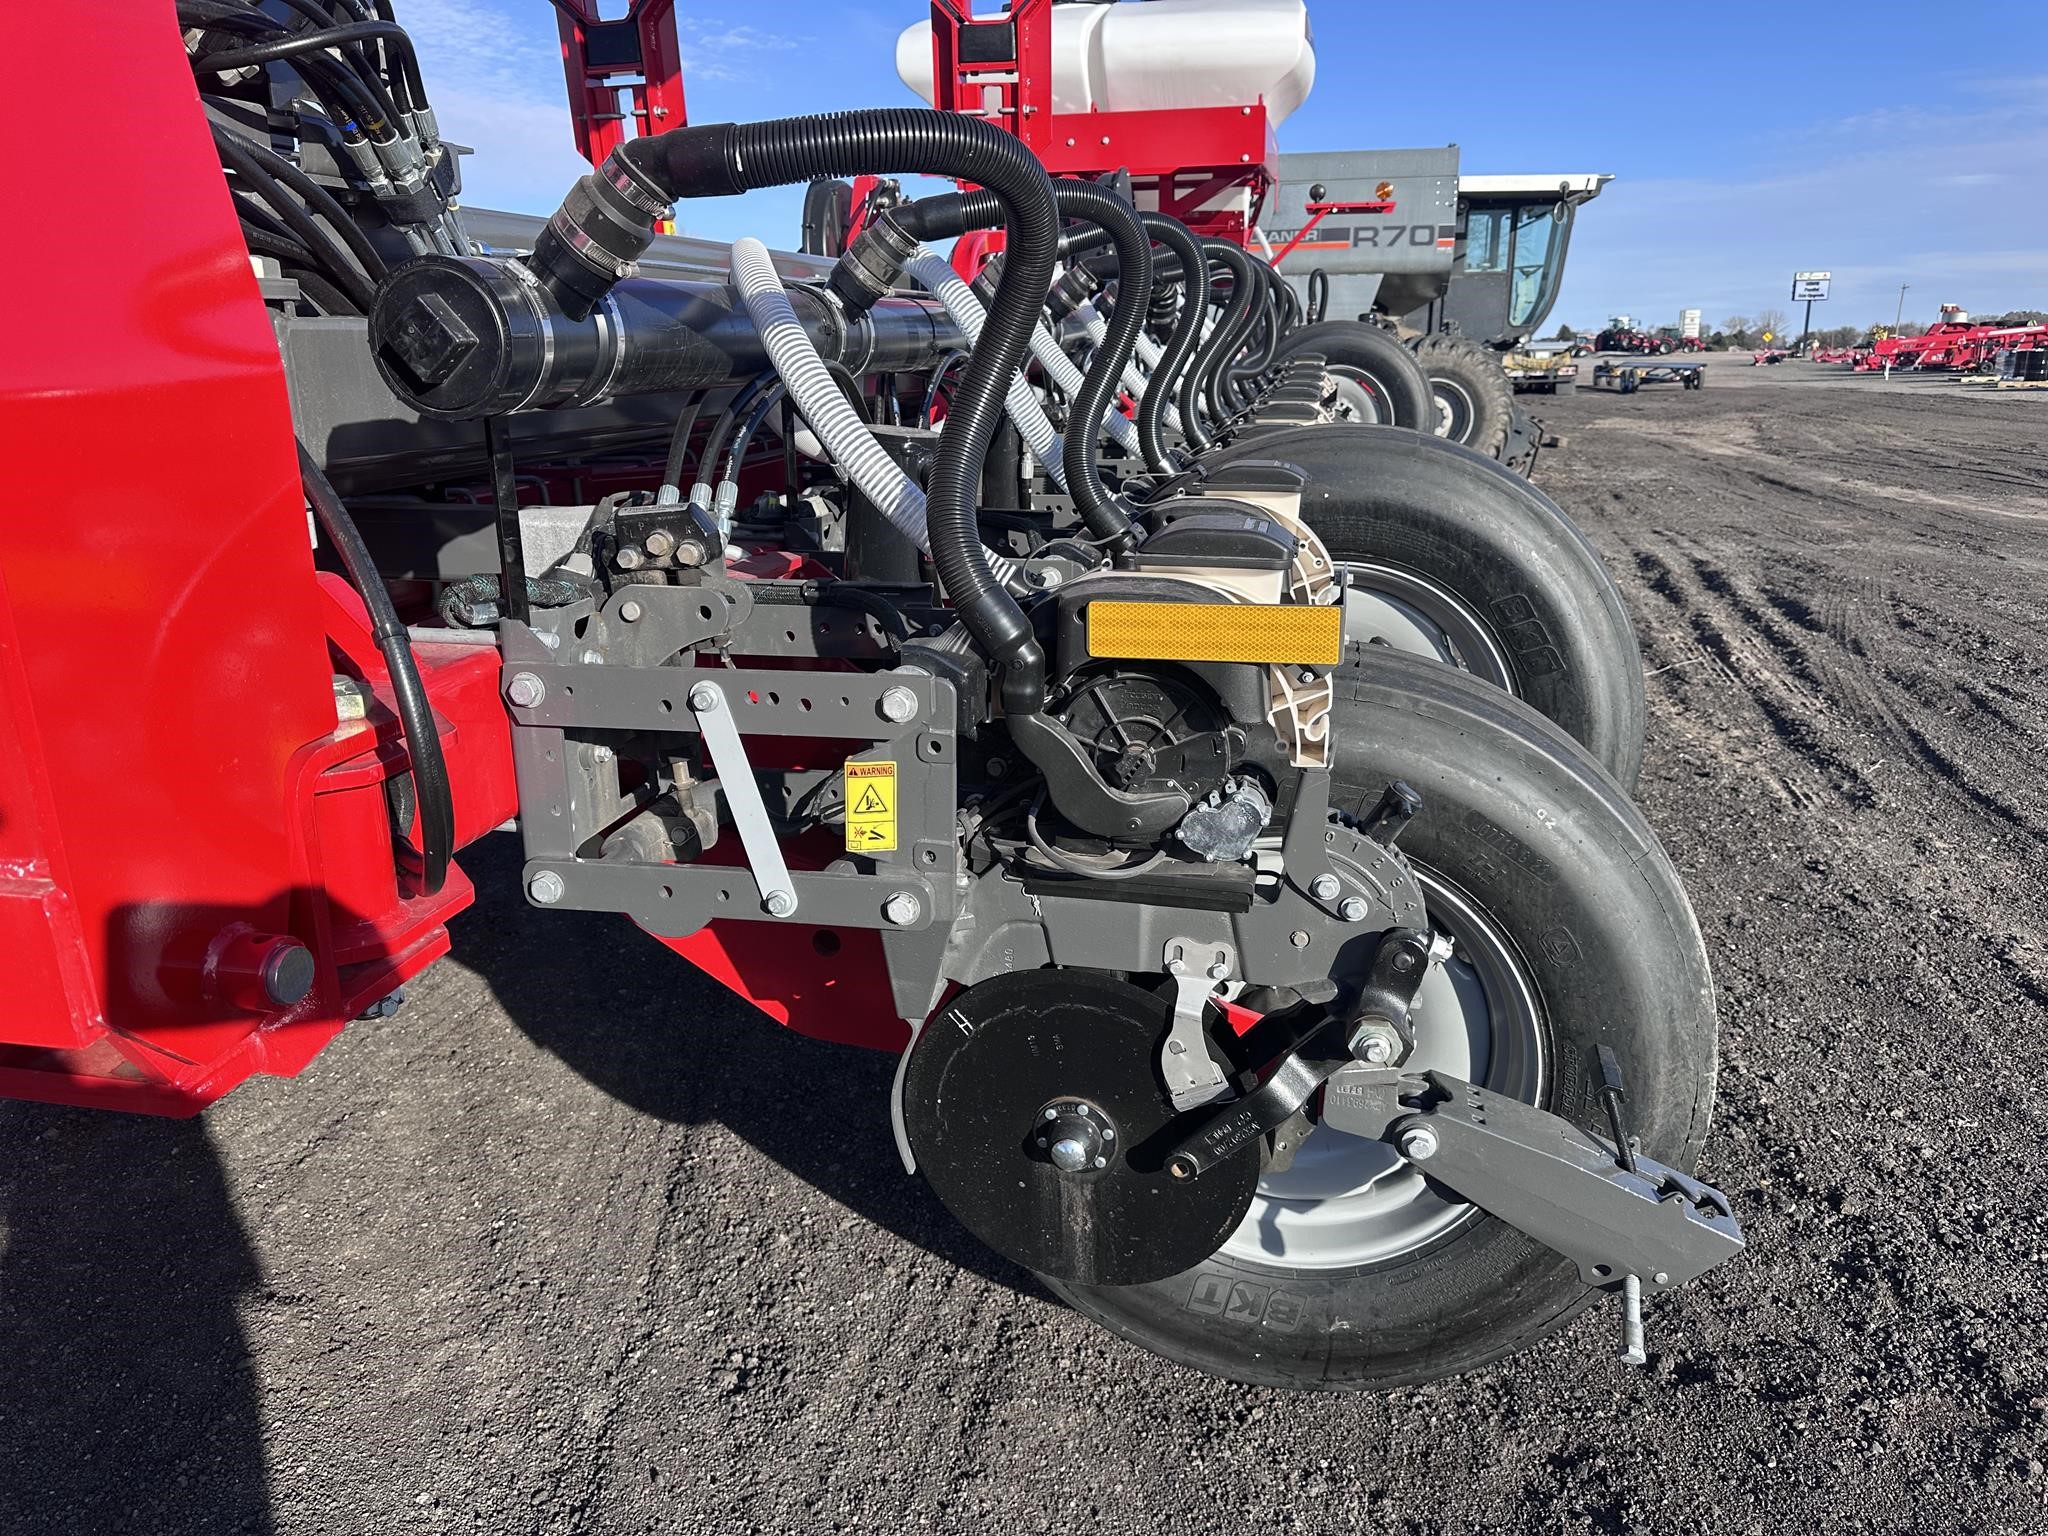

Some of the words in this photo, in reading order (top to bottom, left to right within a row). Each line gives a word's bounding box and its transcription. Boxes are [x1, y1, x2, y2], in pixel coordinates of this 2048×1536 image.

[1352, 225, 1436, 247] R70
[859, 766, 893, 776] WARNING
[1370, 857, 1386, 870] 2
[1389, 876, 1405, 889] 3
[1403, 900, 1418, 912] 4
[1190, 1279, 1302, 1328] BKT
